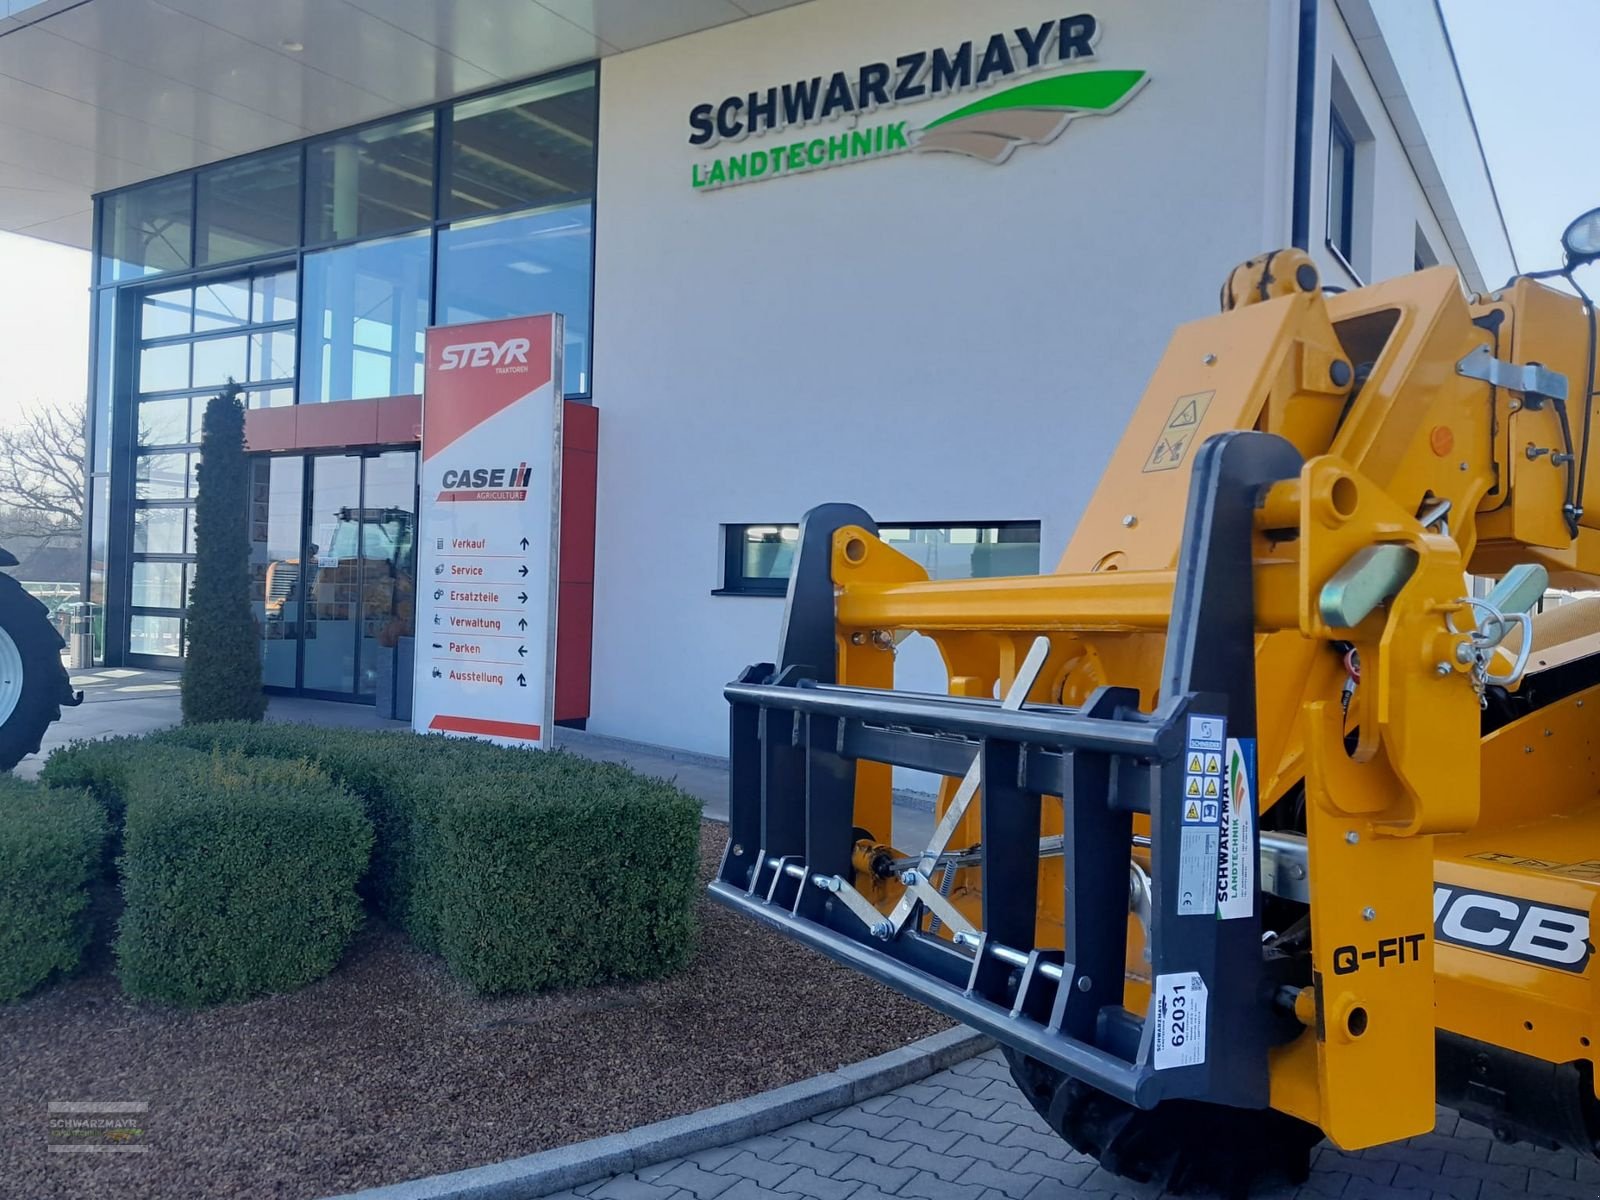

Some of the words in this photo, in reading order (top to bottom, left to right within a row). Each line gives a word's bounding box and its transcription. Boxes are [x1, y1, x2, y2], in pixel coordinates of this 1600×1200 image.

[689, 13, 1098, 146] SCHWARZMAYR
[692, 120, 910, 189] LANDTECHNIK
[438, 338, 530, 370] STEYR
[496, 366, 529, 375] TRAKTOREN
[443, 469, 505, 489] CASE
[476, 491, 524, 500] AGRICULTURE
[451, 537, 486, 550] Verkauf
[451, 564, 484, 577] Service
[450, 590, 500, 604] Ersatzteile
[450, 616, 501, 630] Verwaltung
[449, 642, 481, 655] Parken
[449, 670, 504, 686] Ausstellung
[1231, 818, 1240, 899] LANDTECHNIK
[1333, 933, 1425, 975] Q-FIT
[1171, 985, 1186, 1047] 62031
